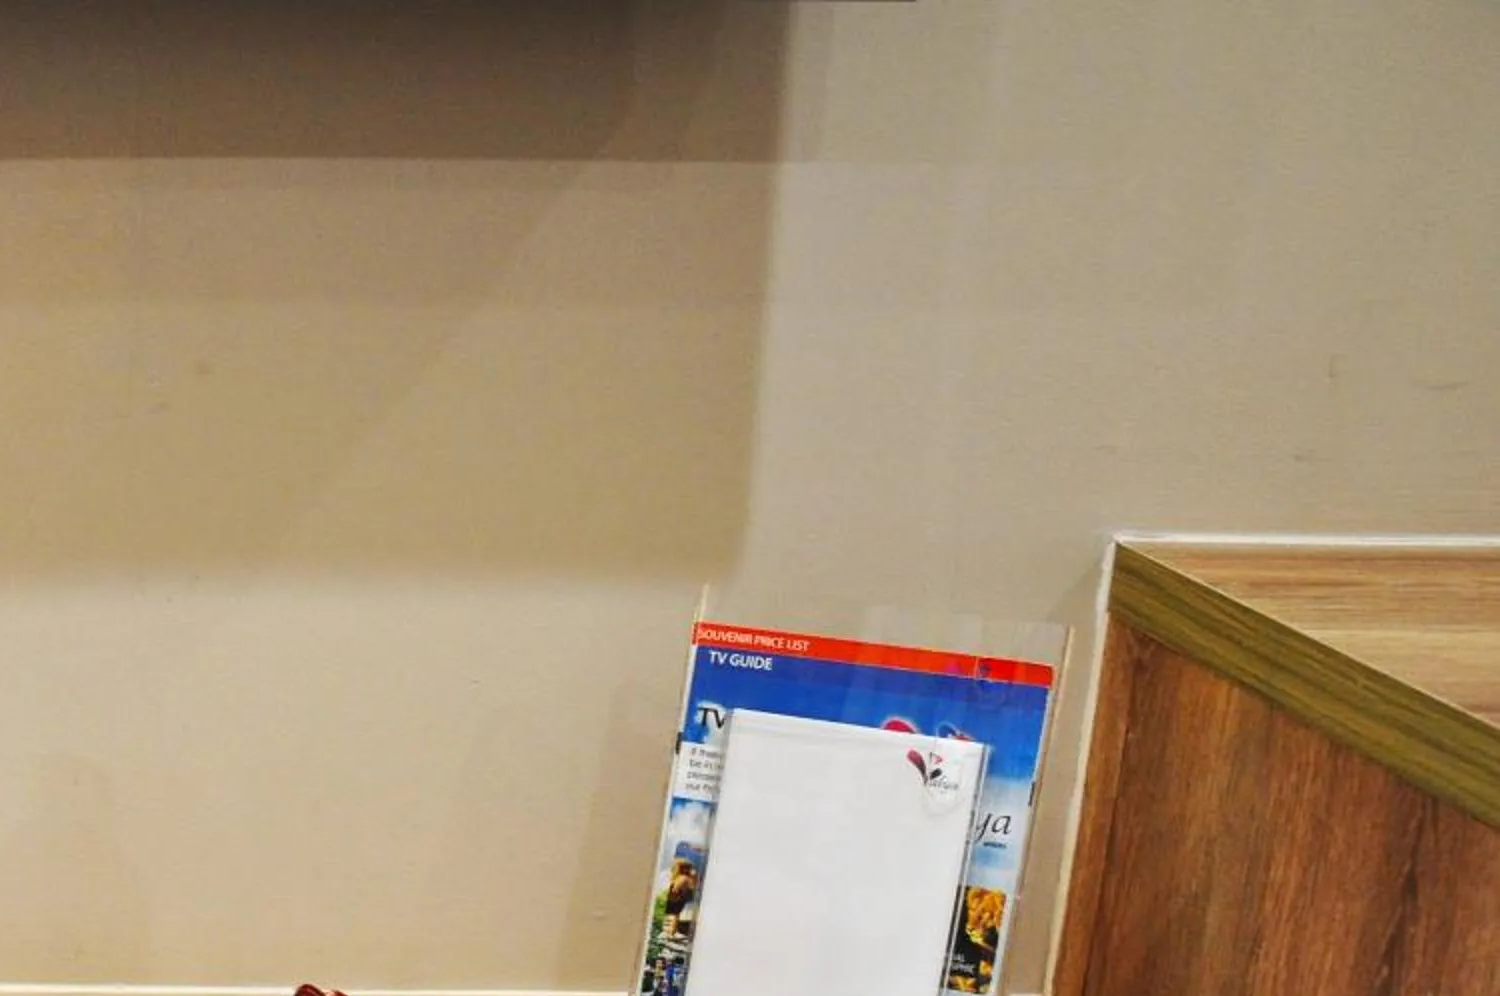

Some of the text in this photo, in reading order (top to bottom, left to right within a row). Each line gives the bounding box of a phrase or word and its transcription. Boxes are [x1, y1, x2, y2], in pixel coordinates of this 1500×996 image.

[699, 628, 811, 651] SOUVENIR PRICE LIST
[709, 650, 773, 671] TV GUIDE
